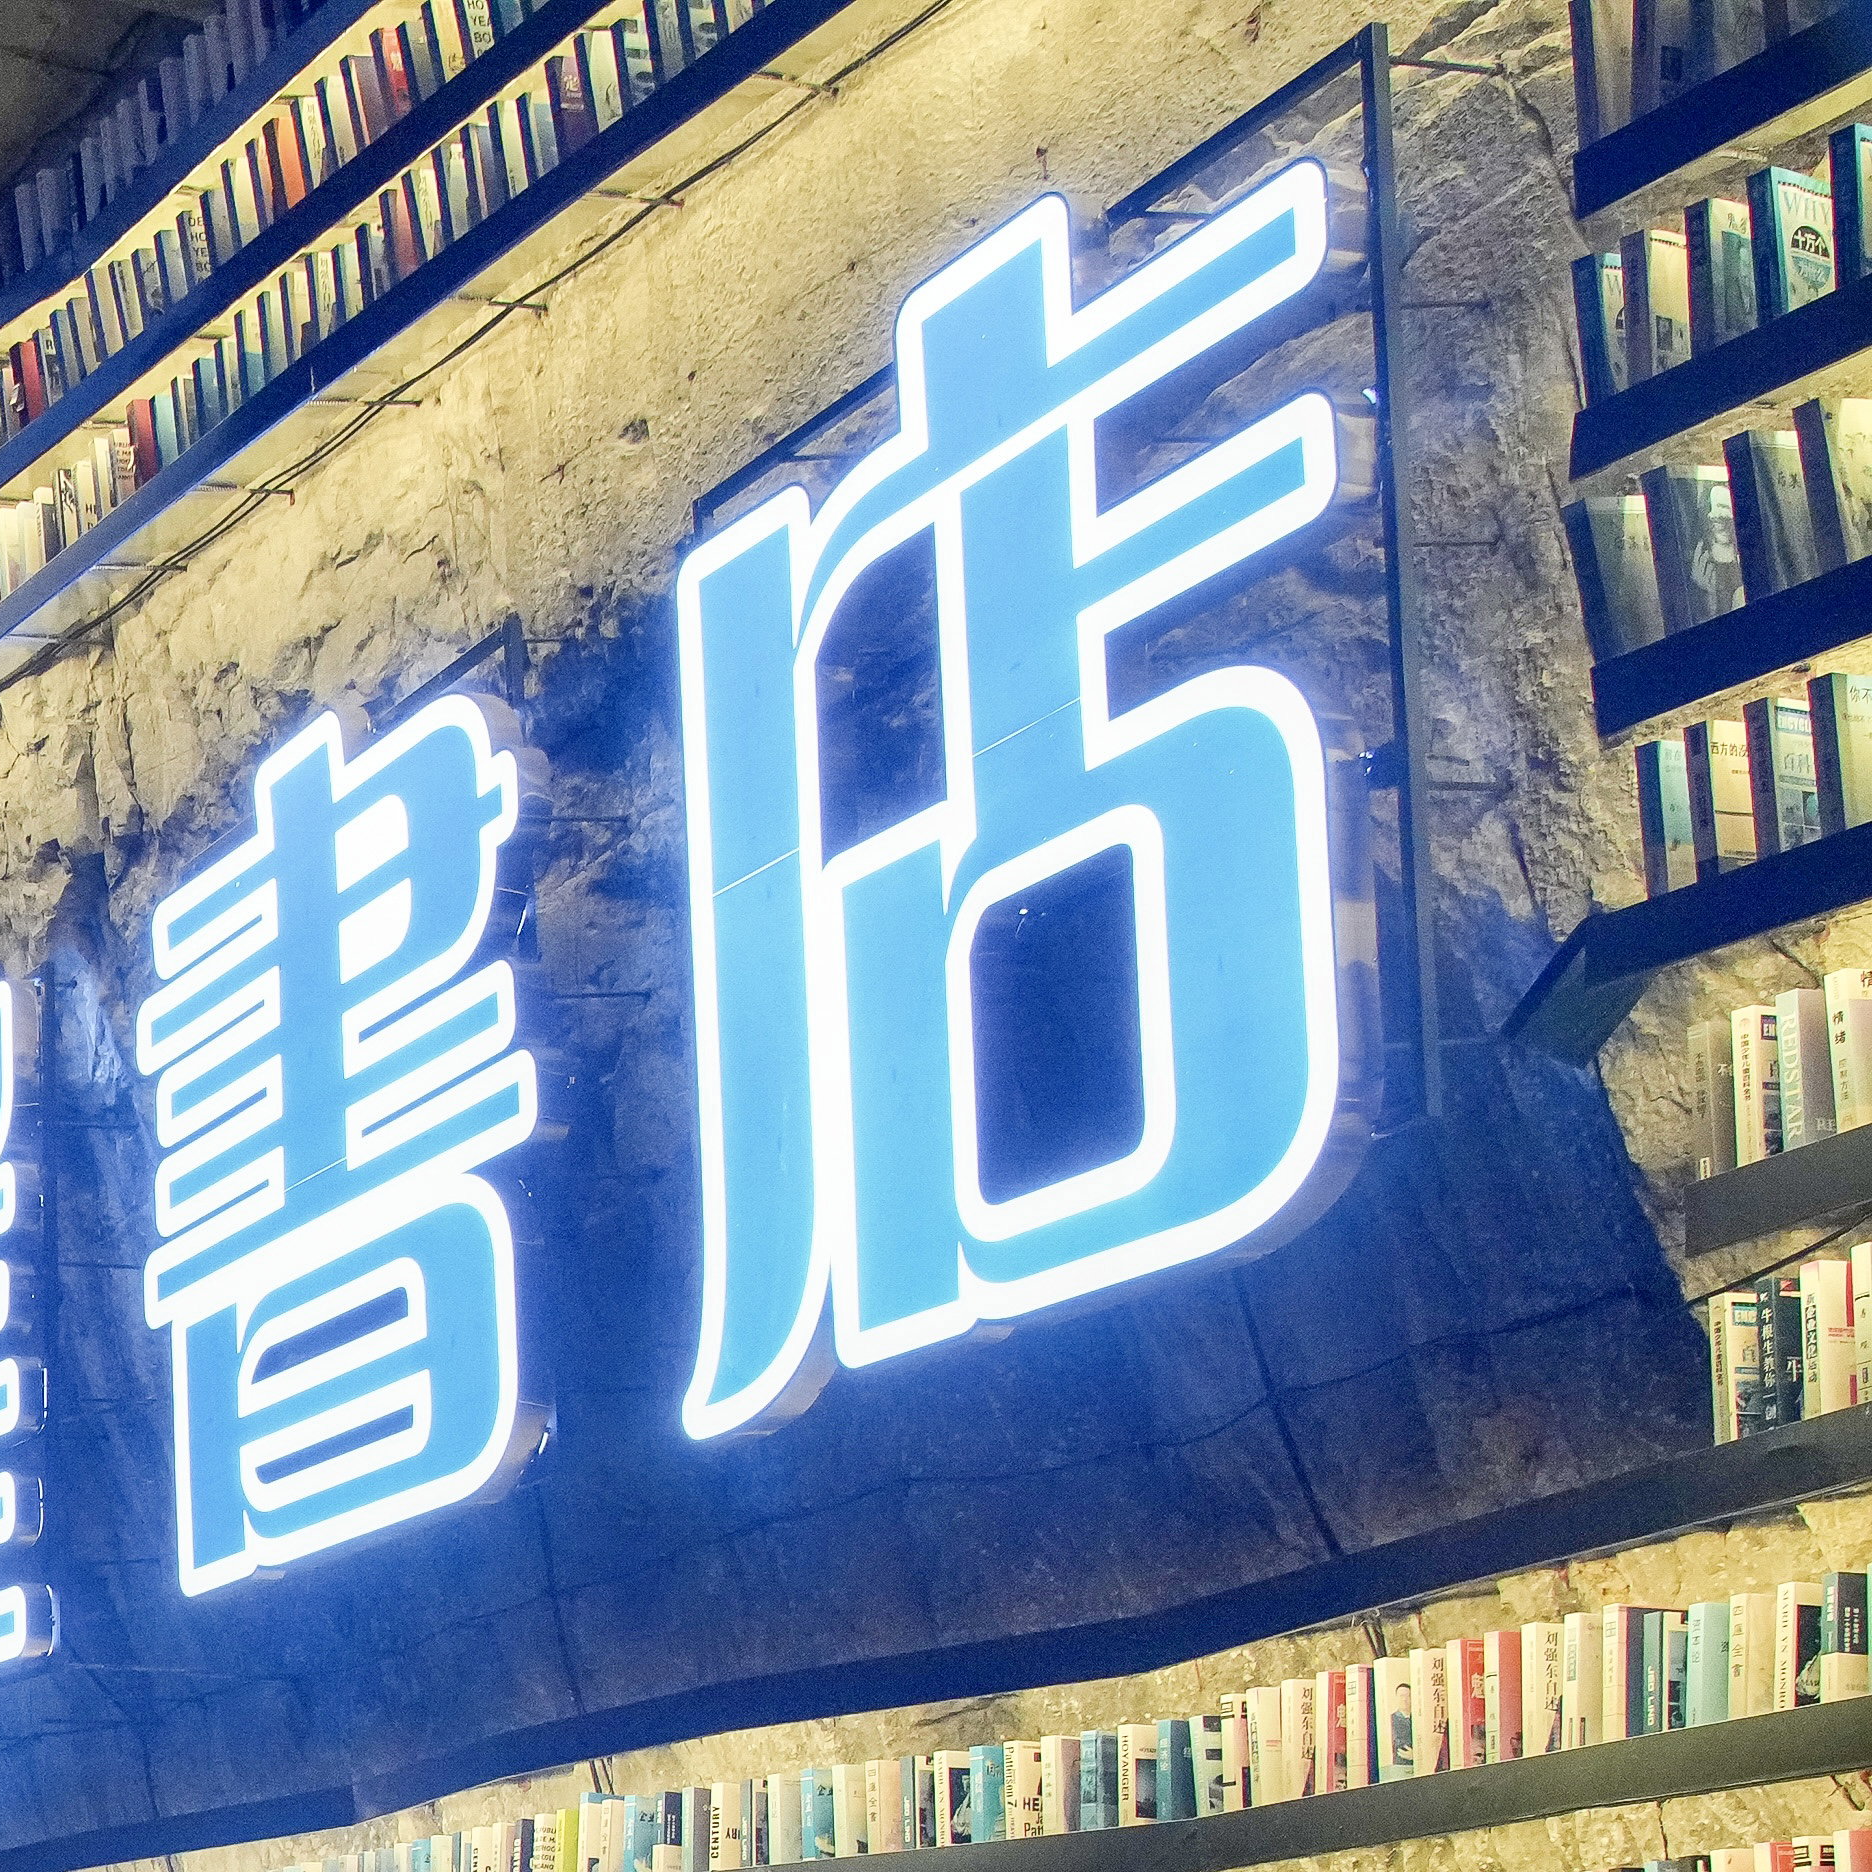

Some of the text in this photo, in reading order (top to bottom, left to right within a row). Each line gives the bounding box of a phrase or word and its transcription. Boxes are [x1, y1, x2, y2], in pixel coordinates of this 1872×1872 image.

[1783, 191, 1831, 225] WHY
[1430, 1657, 1447, 1734] 刘强东自述
[1543, 1631, 1559, 1712] 刘强东自述
[1121, 1734, 1130, 1802] HOYANGER
[710, 1806, 720, 1859] CENTURY
[1022, 1796, 1043, 1812] HE
